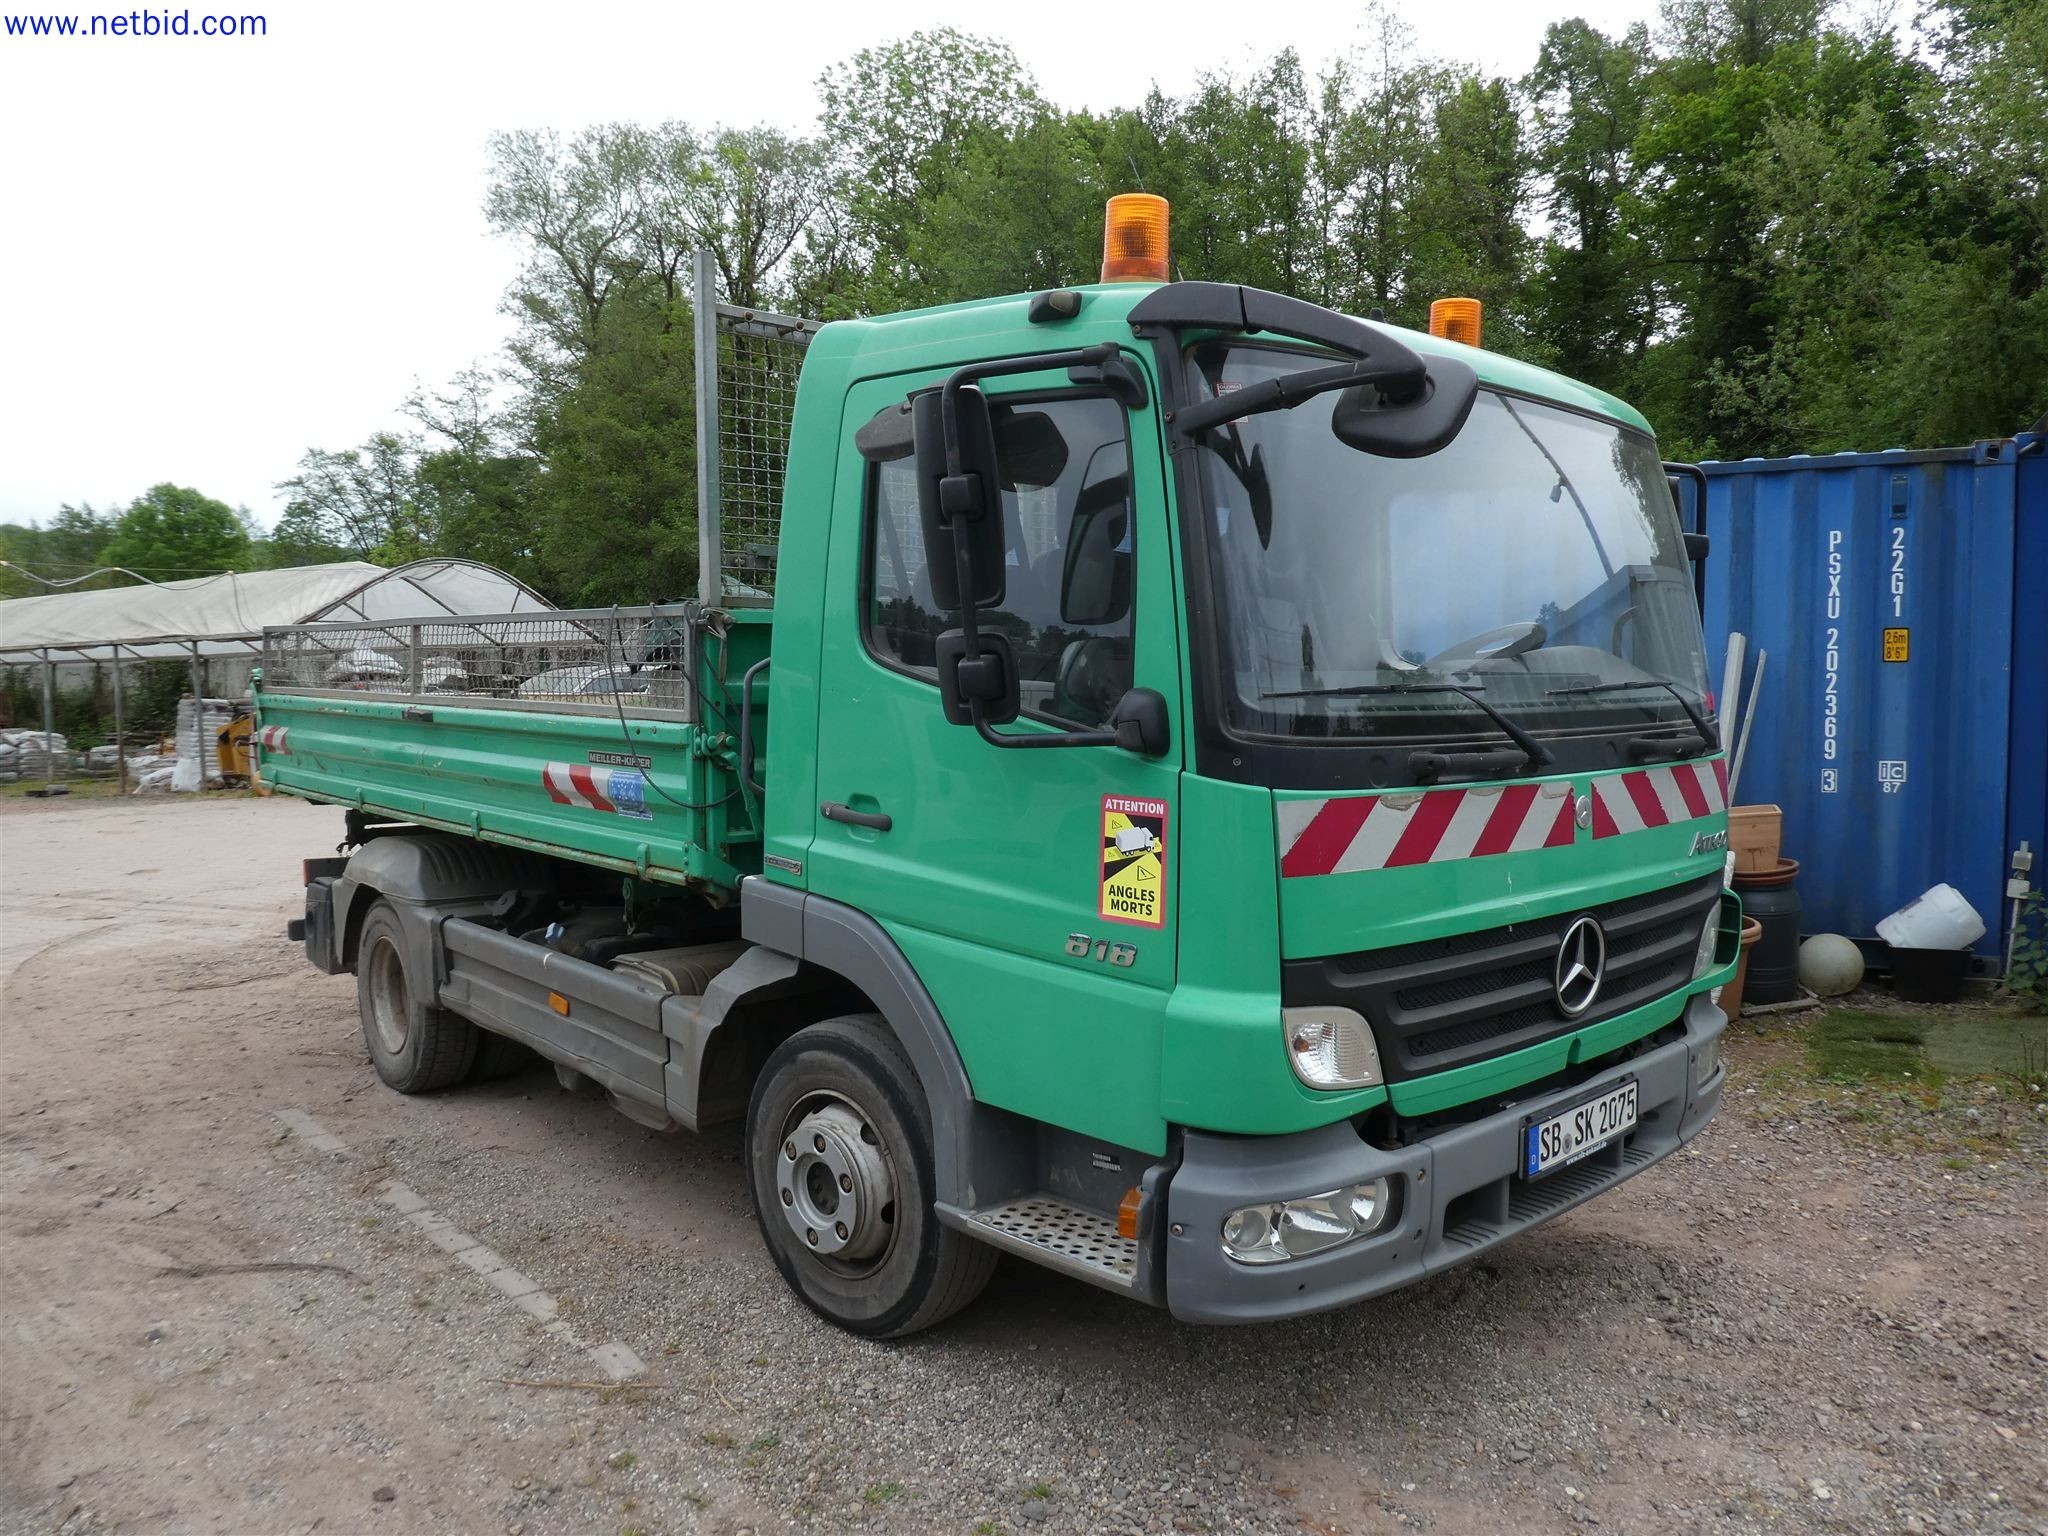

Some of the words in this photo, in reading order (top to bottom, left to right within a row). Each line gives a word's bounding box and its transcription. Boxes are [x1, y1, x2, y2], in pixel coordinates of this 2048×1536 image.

[1827, 530, 1841, 619] PSXU
[1891, 527, 1905, 617] 22G1
[1824, 628, 1838, 760] 202369
[589, 752, 651, 767] MEILLER-KIPER
[1822, 769, 1837, 792] 3
[1883, 782, 1901, 793] 87
[1105, 798, 1164, 815] ATTENTION
[1108, 884, 1155, 902] ANGLES
[1110, 898, 1153, 916] MORTS
[1065, 932, 1137, 968] 818
[1541, 1122, 1561, 1162] SB
[1575, 1105, 1594, 1146] SK
[1599, 1088, 1635, 1134] 2075
[1531, 1154, 1537, 1165] D
